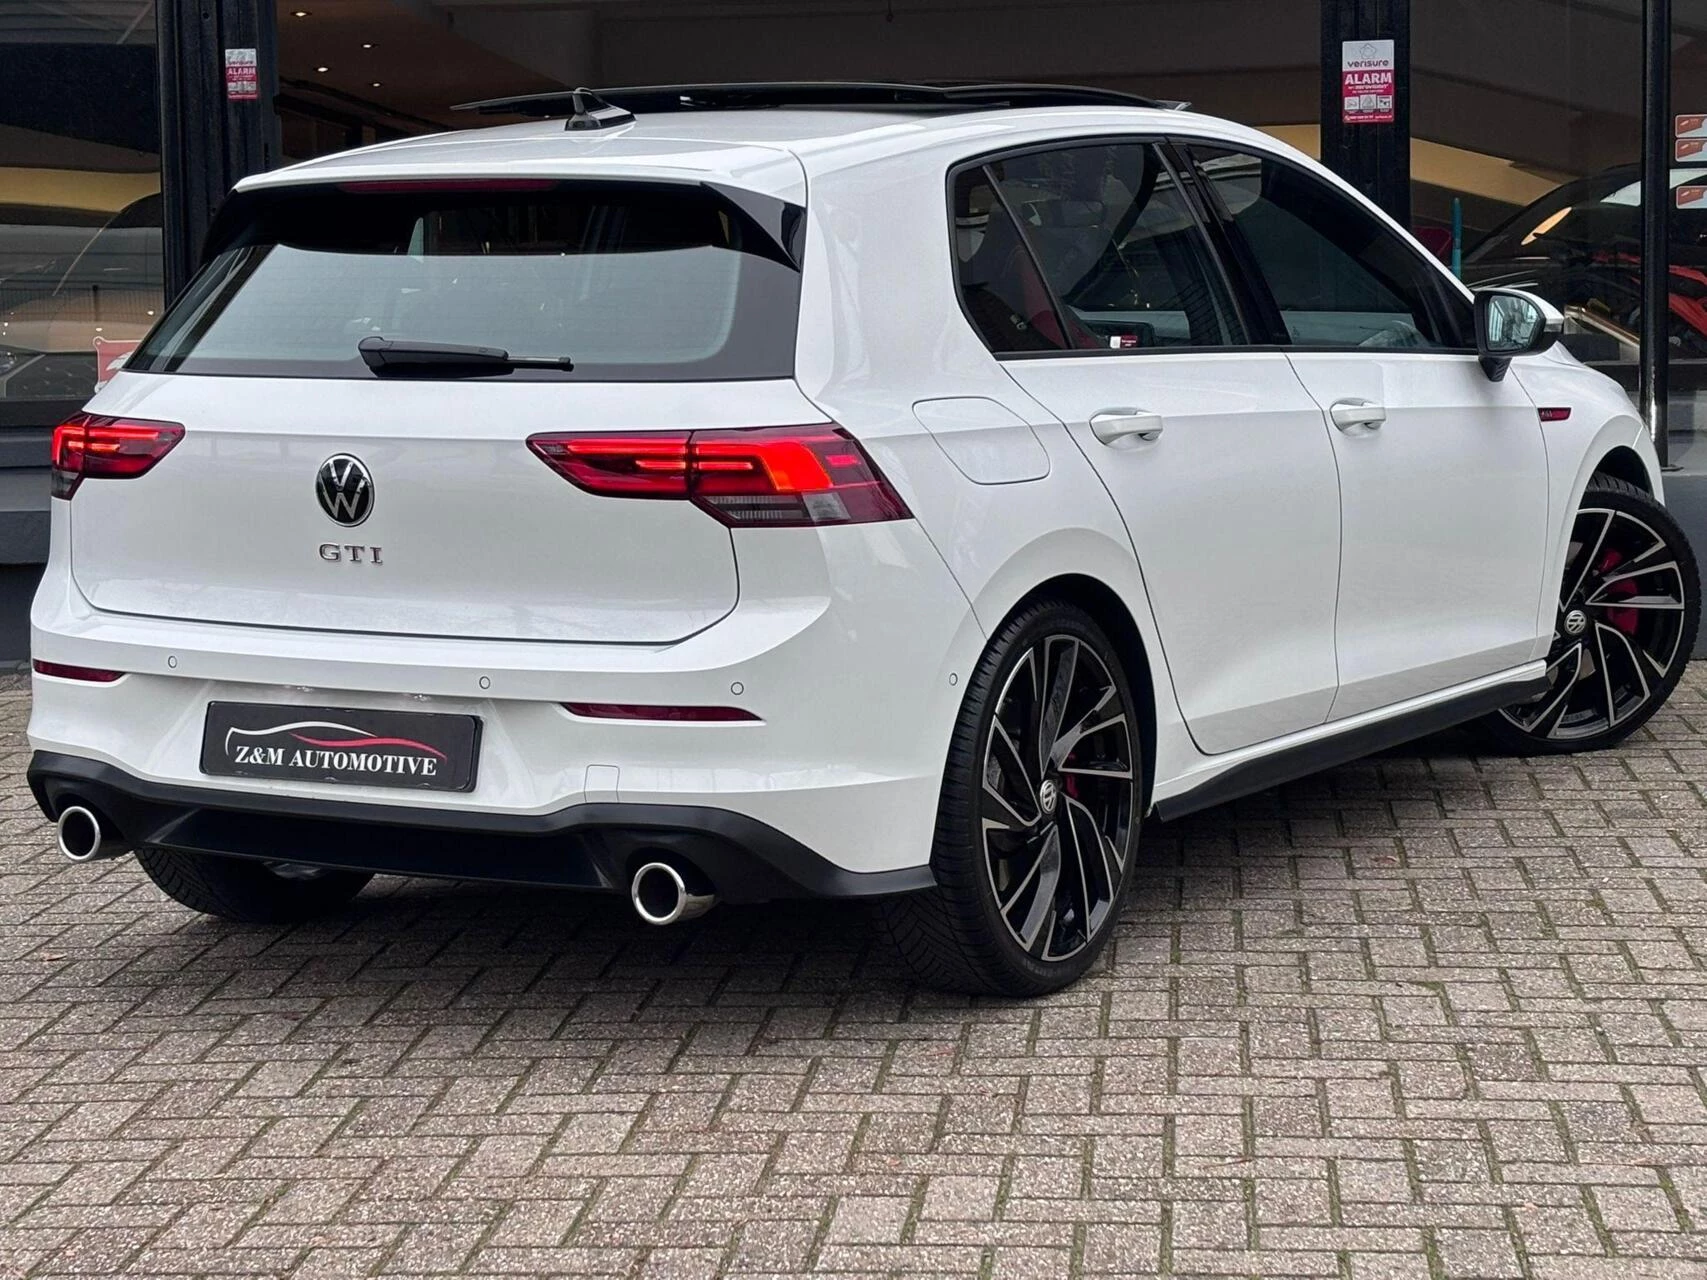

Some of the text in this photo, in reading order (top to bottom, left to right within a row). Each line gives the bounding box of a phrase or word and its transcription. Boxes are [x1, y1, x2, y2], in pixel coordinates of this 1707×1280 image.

[1347, 60, 1389, 68] verisure
[228, 67, 256, 75] ALARM
[1344, 72, 1393, 85] ALARM
[319, 543, 383, 565] GTI
[234, 745, 437, 776] Z&M AUTOMOTIVE
